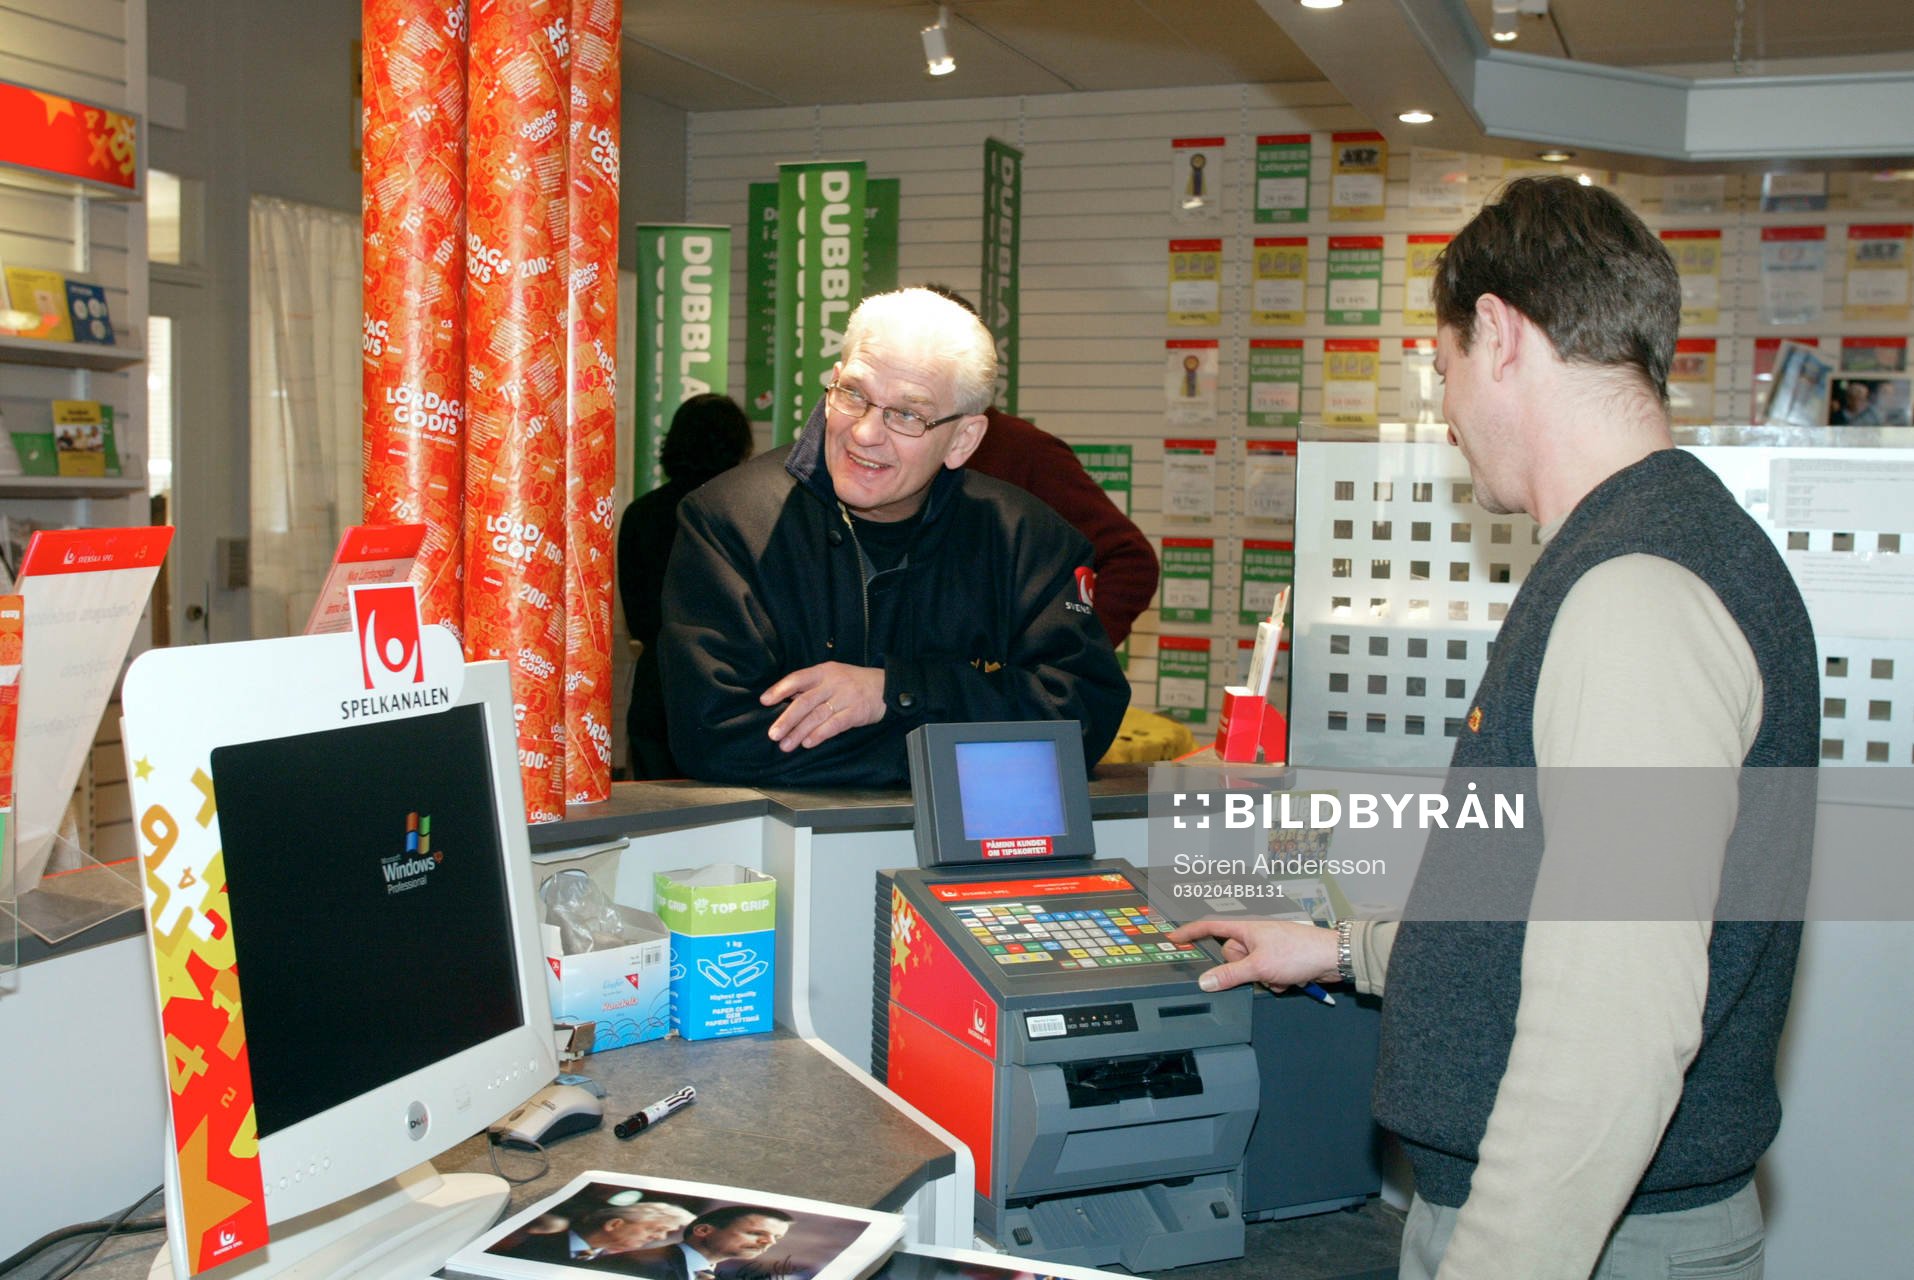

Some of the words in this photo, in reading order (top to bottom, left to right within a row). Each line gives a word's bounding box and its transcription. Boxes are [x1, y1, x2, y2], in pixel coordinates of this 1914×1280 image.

[386, 382, 465, 422] LÖRDAGS
[394, 405, 457, 435] GODIS
[340, 687, 450, 721] SPELKANALEN
[986, 840, 1014, 849] PÅMINN
[1017, 839, 1047, 847] KUNDEN
[987, 849, 1000, 857] OM
[1002, 847, 1047, 856] TIPSKORTET!
[382, 857, 435, 882] Windows
[711, 900, 737, 914] TOP
[741, 899, 770, 913] GRIP
